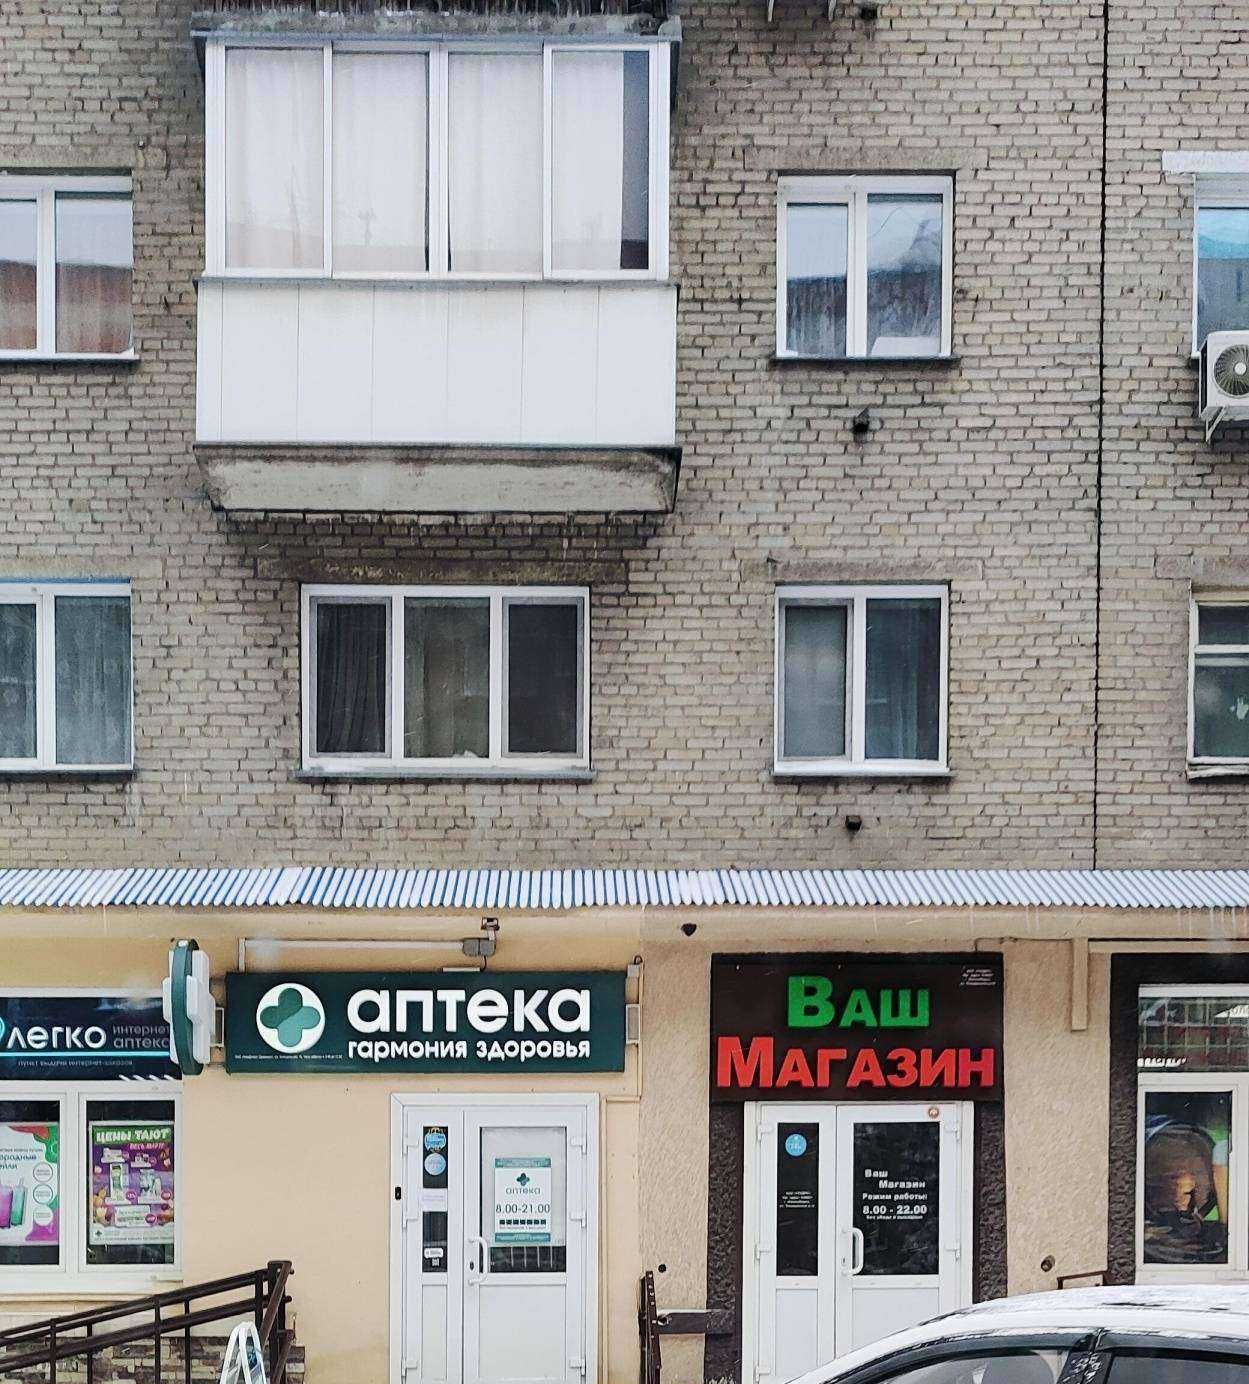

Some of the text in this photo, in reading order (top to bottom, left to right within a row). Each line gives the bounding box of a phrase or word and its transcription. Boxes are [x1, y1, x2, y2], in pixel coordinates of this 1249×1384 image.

[347, 989, 591, 1033] аптека
[6, 1026, 107, 1049] легко
[348, 1040, 591, 1062] гармония здоровья
[96, 1128, 171, 1142] ЦЕНЫ ТАЮТ
[879, 1180, 926, 1188] Магазин
[862, 1205, 887, 1214] 8.00
[896, 1204, 928, 1214] 22.00
